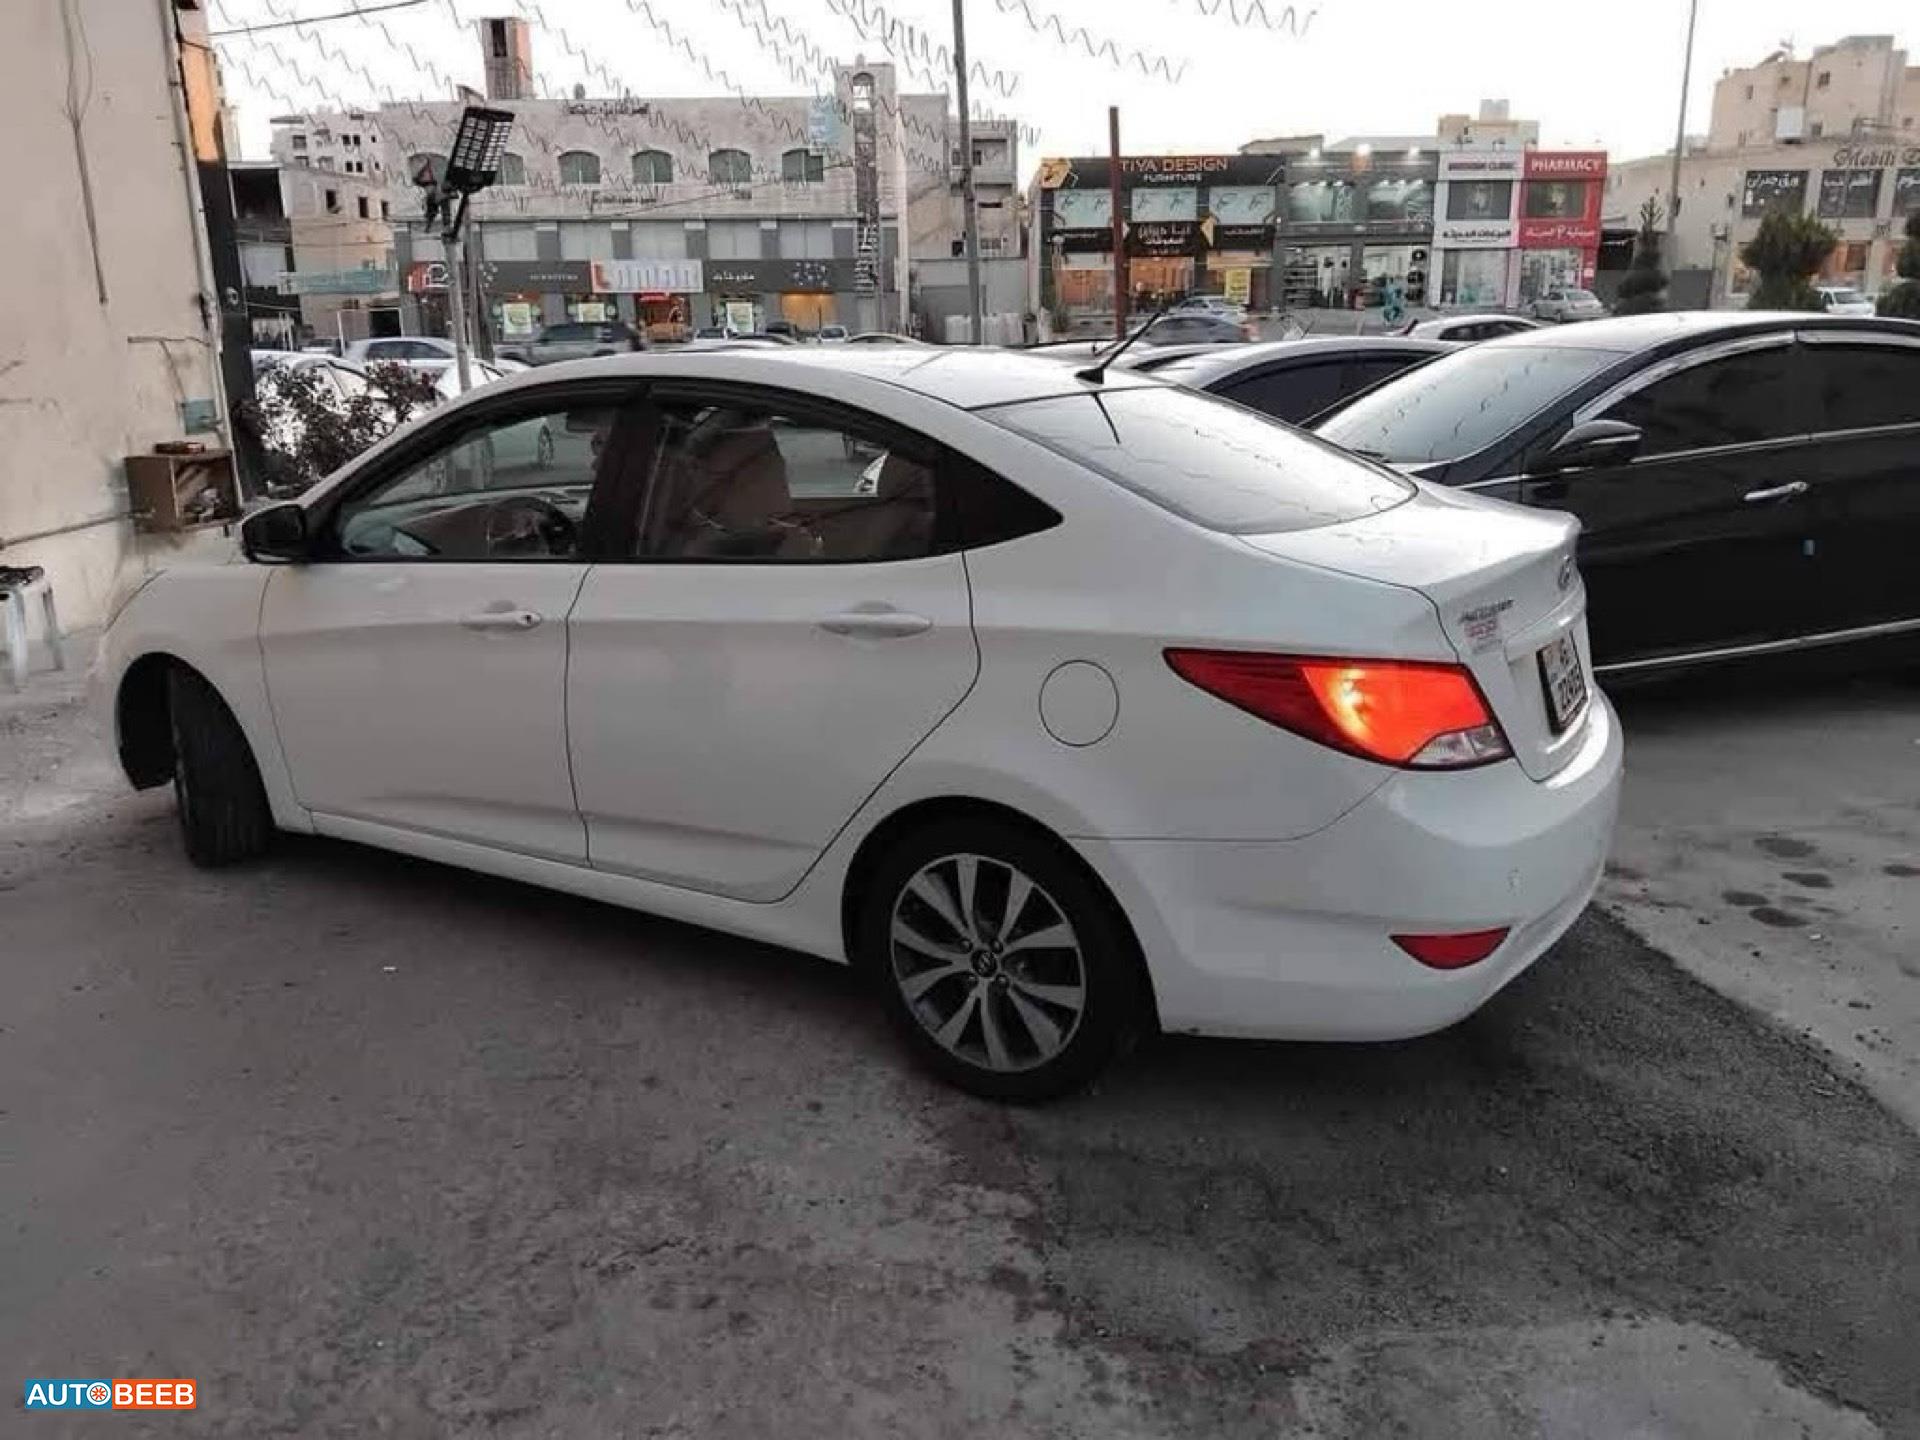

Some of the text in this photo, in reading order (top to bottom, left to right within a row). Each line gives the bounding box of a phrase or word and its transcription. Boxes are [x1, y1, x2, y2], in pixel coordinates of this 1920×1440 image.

[1162, 157, 1229, 172] DESIGN
[1531, 158, 1602, 173] PHARMACY
[1143, 172, 1202, 183] FURNITURE
